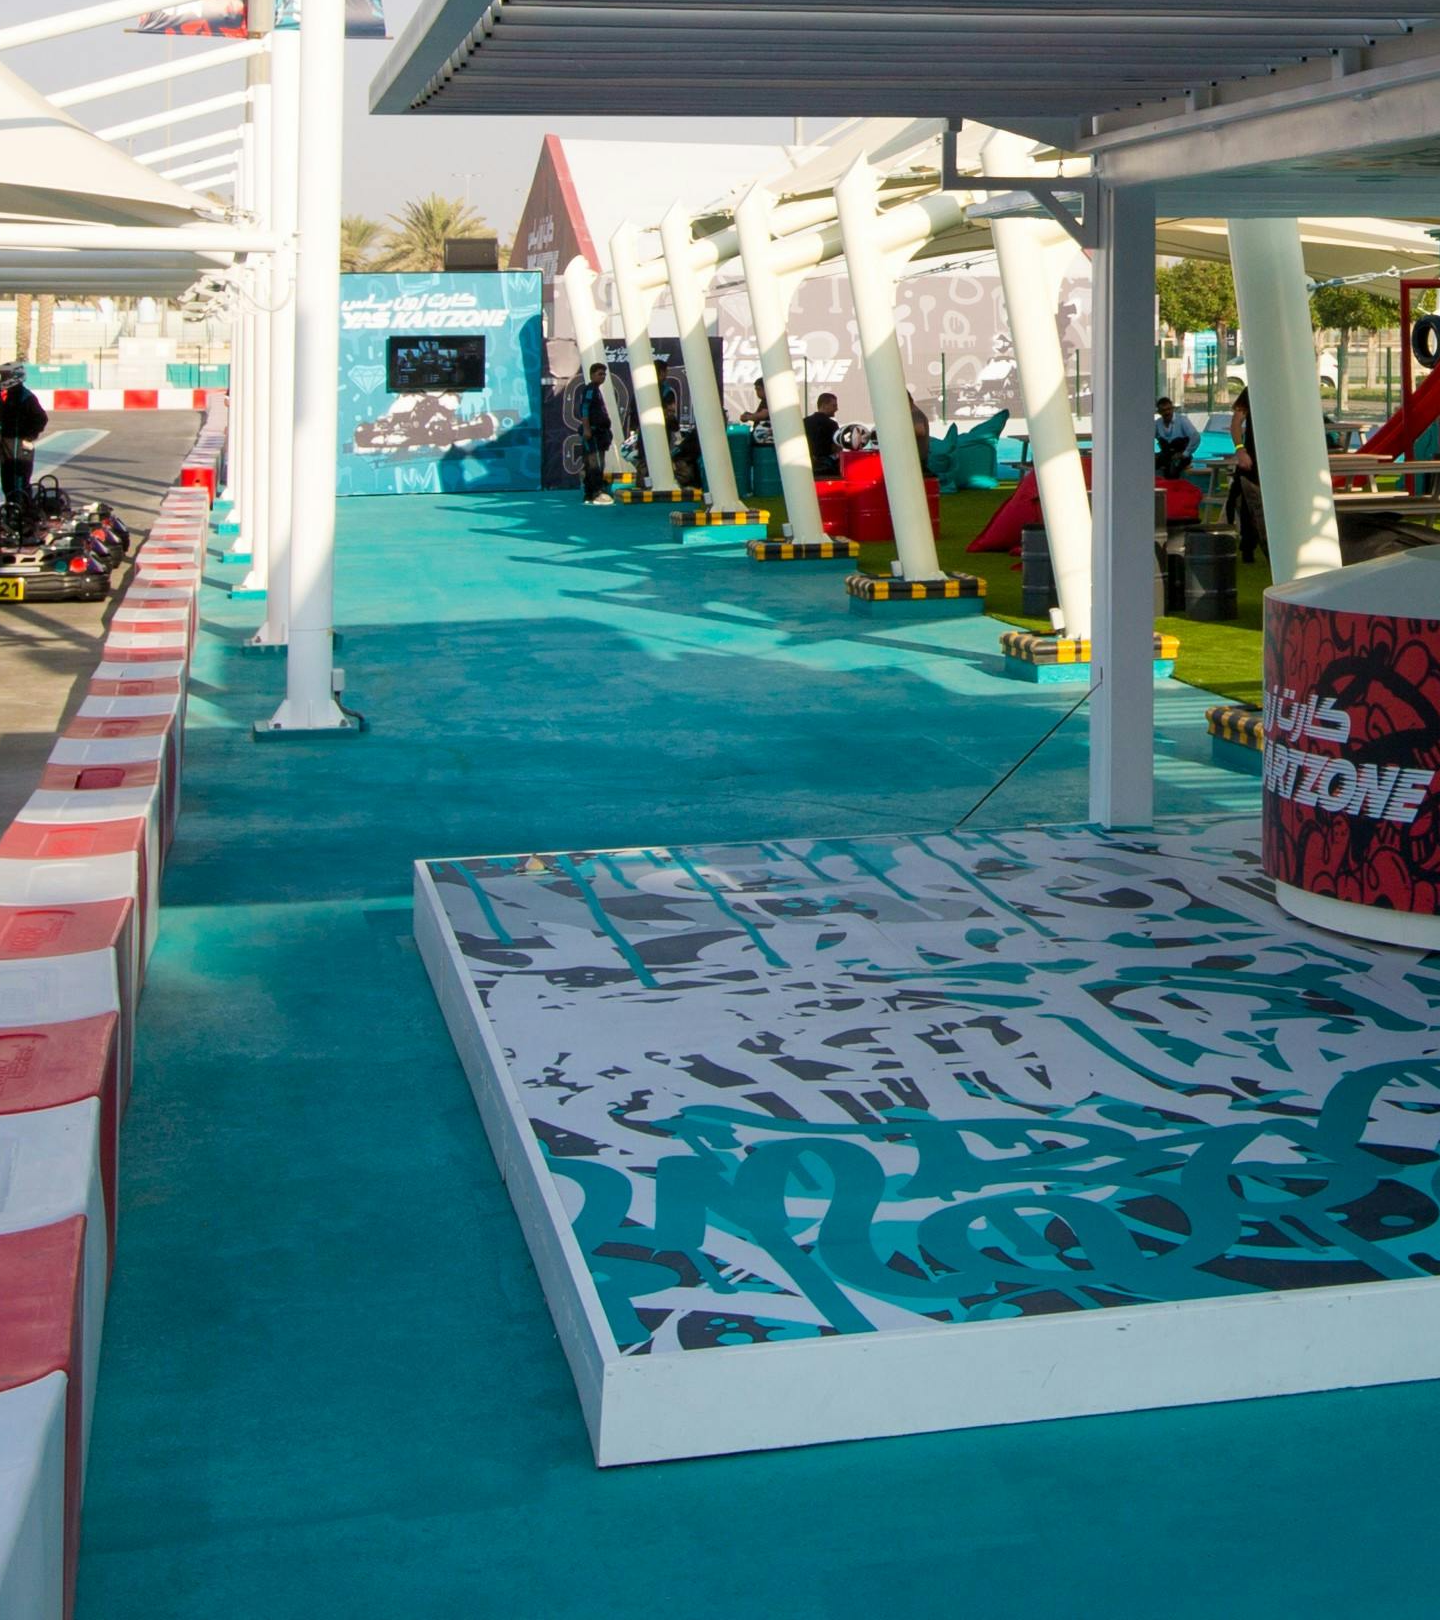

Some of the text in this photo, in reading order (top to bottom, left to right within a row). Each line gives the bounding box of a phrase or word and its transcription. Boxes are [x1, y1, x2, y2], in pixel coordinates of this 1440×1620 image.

[341, 309, 510, 330] YAS KARTZONE
[1263, 740, 1436, 824] ARTZONE
